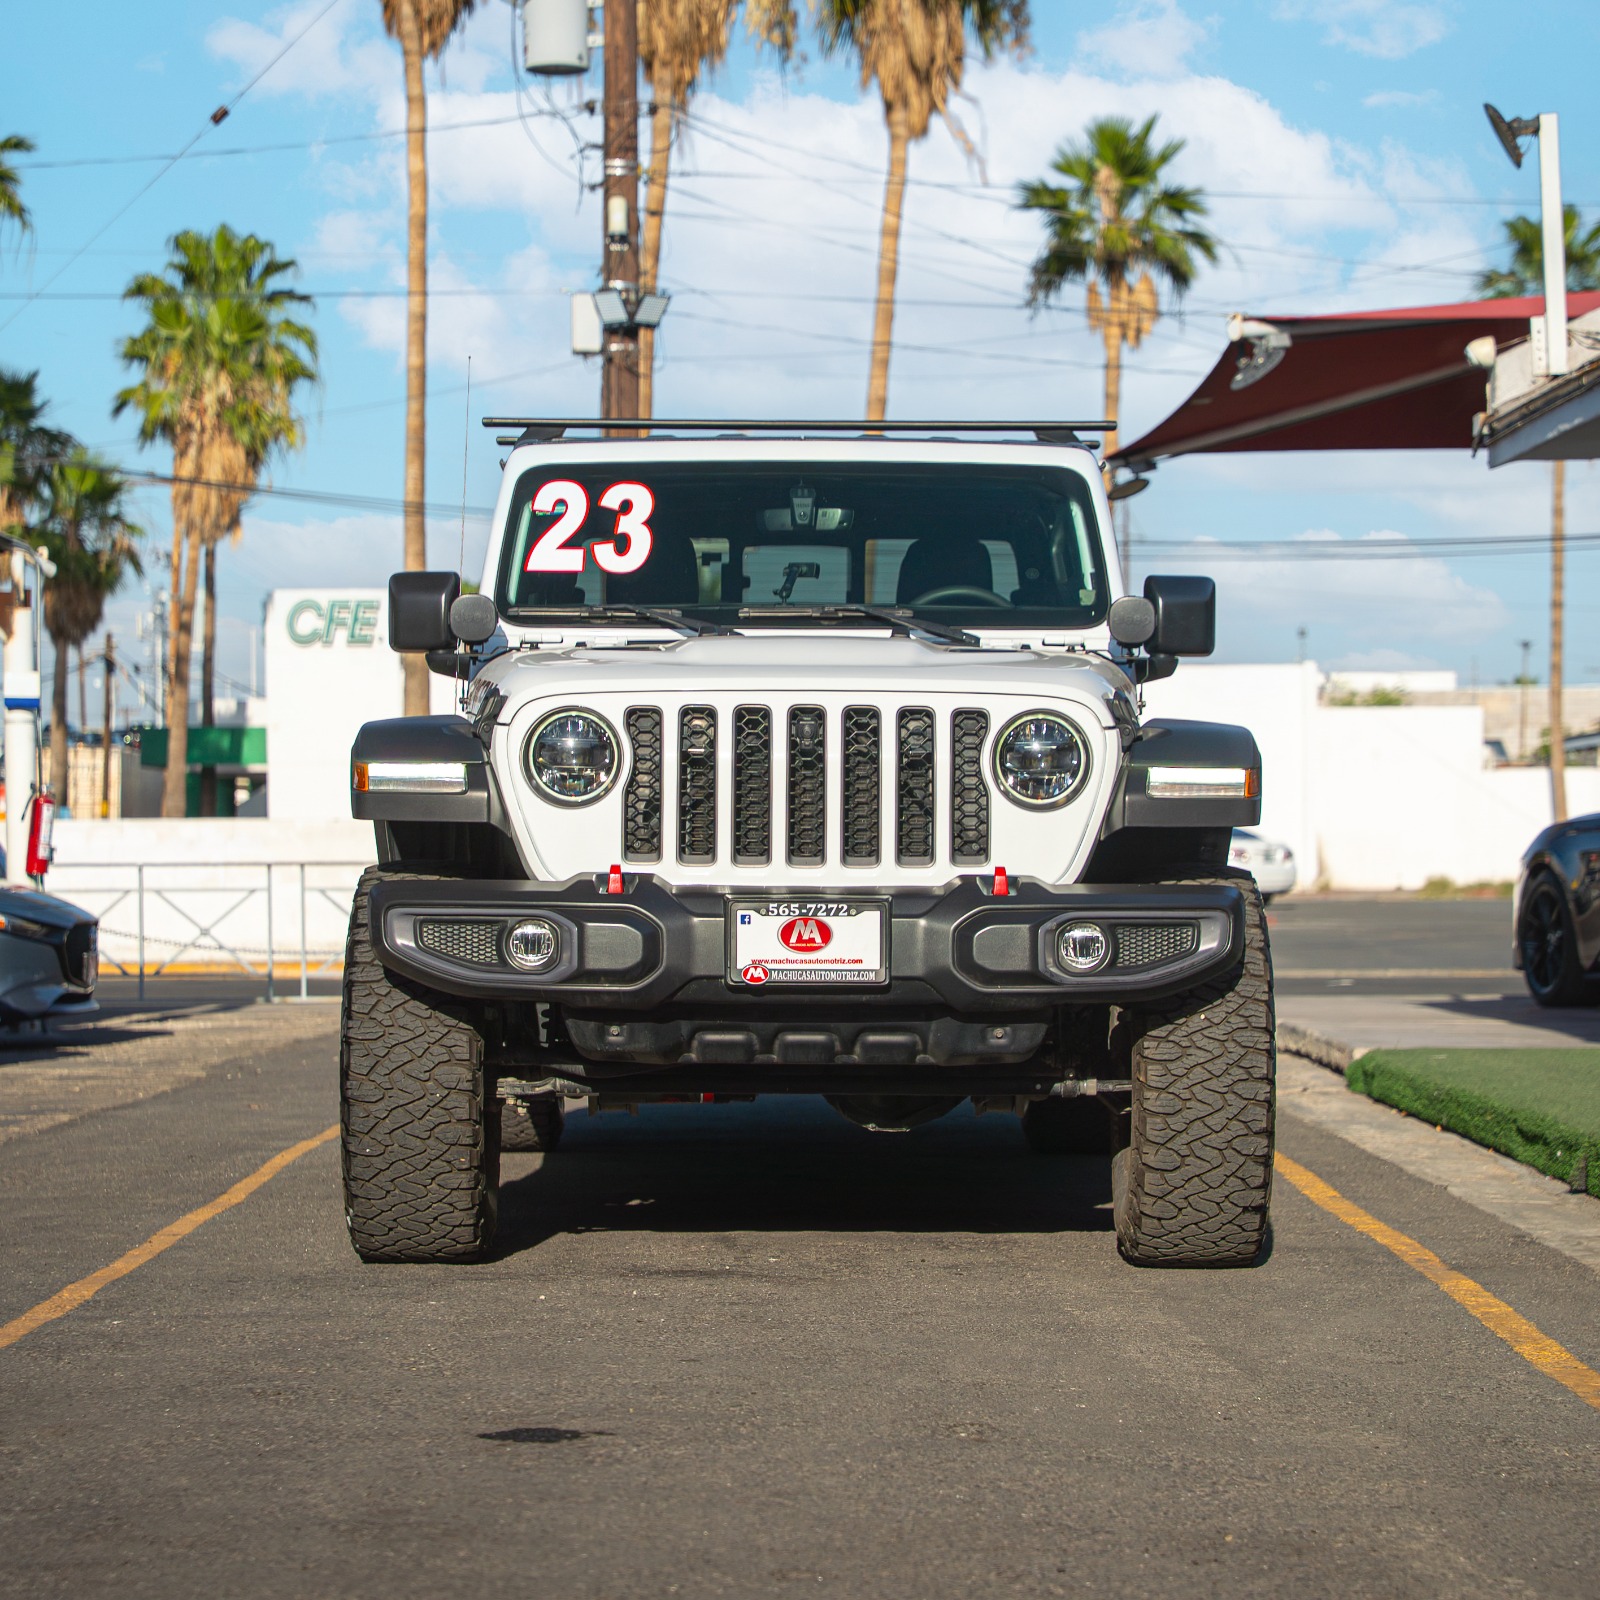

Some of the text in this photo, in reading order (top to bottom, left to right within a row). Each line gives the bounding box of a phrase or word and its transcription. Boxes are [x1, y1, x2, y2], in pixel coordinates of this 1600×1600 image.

[523, 478, 655, 574] 23
[287, 599, 381, 645] CFE
[768, 903, 848, 916] 565-7272
[771, 971, 876, 981] MACHUCASAUTOMOTRIZ.COM
